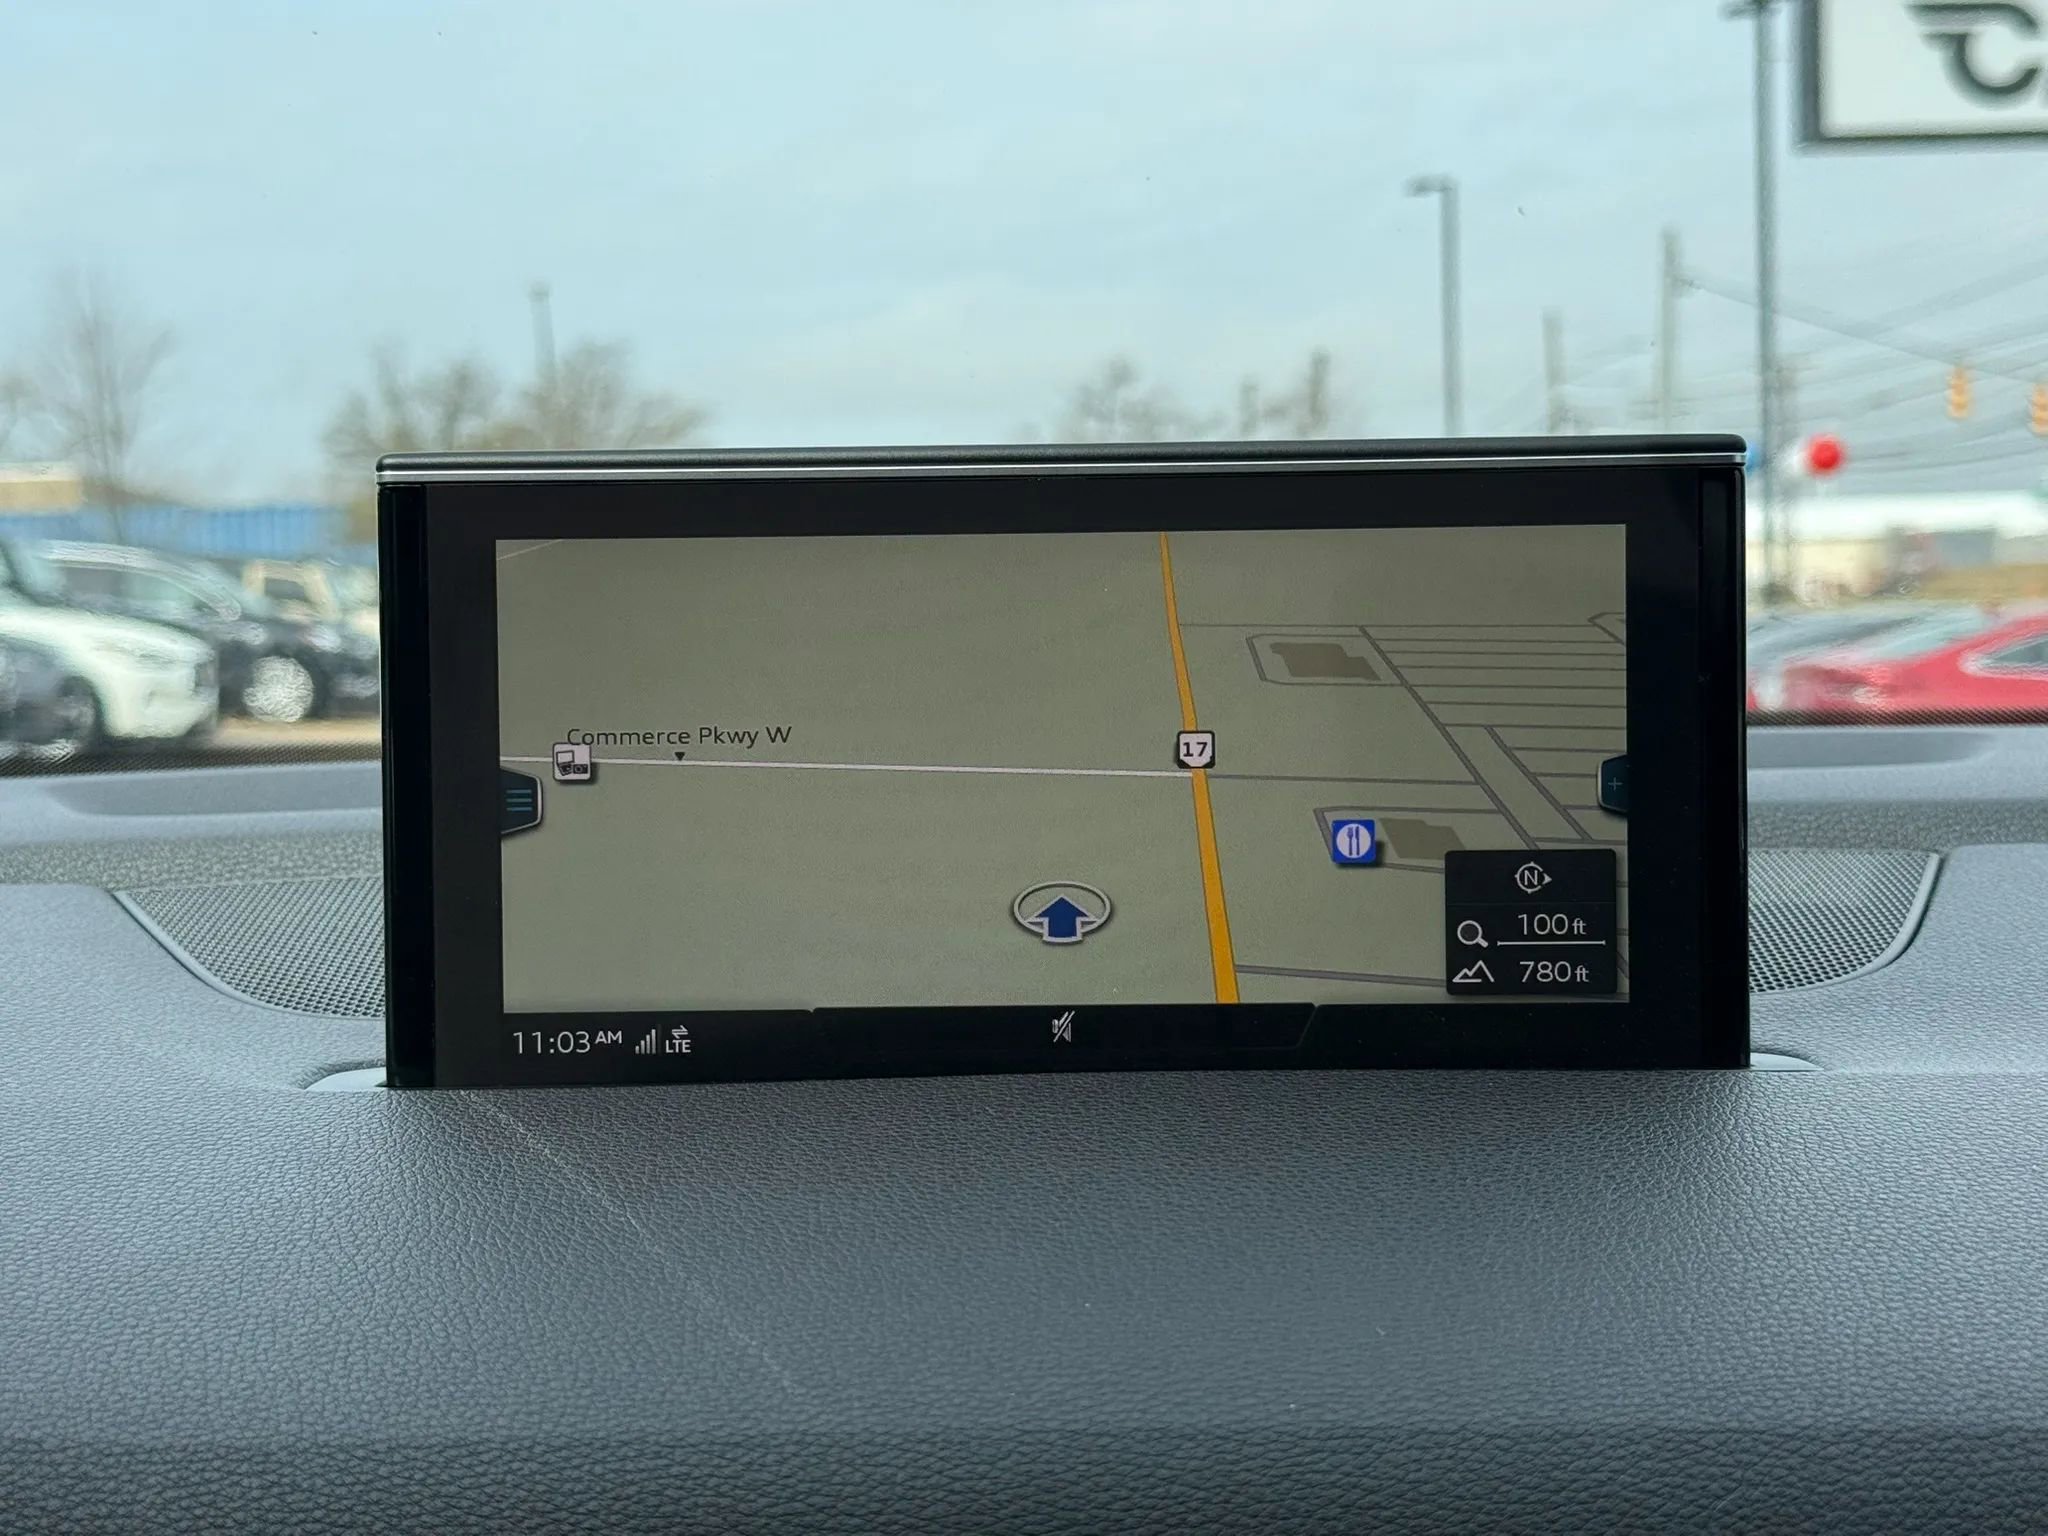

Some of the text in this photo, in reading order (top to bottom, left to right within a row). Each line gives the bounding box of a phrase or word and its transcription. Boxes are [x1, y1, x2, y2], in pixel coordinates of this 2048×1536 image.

[567, 725, 793, 749] Commerce Pkwy W
[1182, 741, 1208, 757] 17
[1523, 869, 1539, 886] N
[1517, 913, 1587, 935] 100 ft
[1519, 961, 1590, 983] 780 ft
[665, 1039, 692, 1054] LTE
